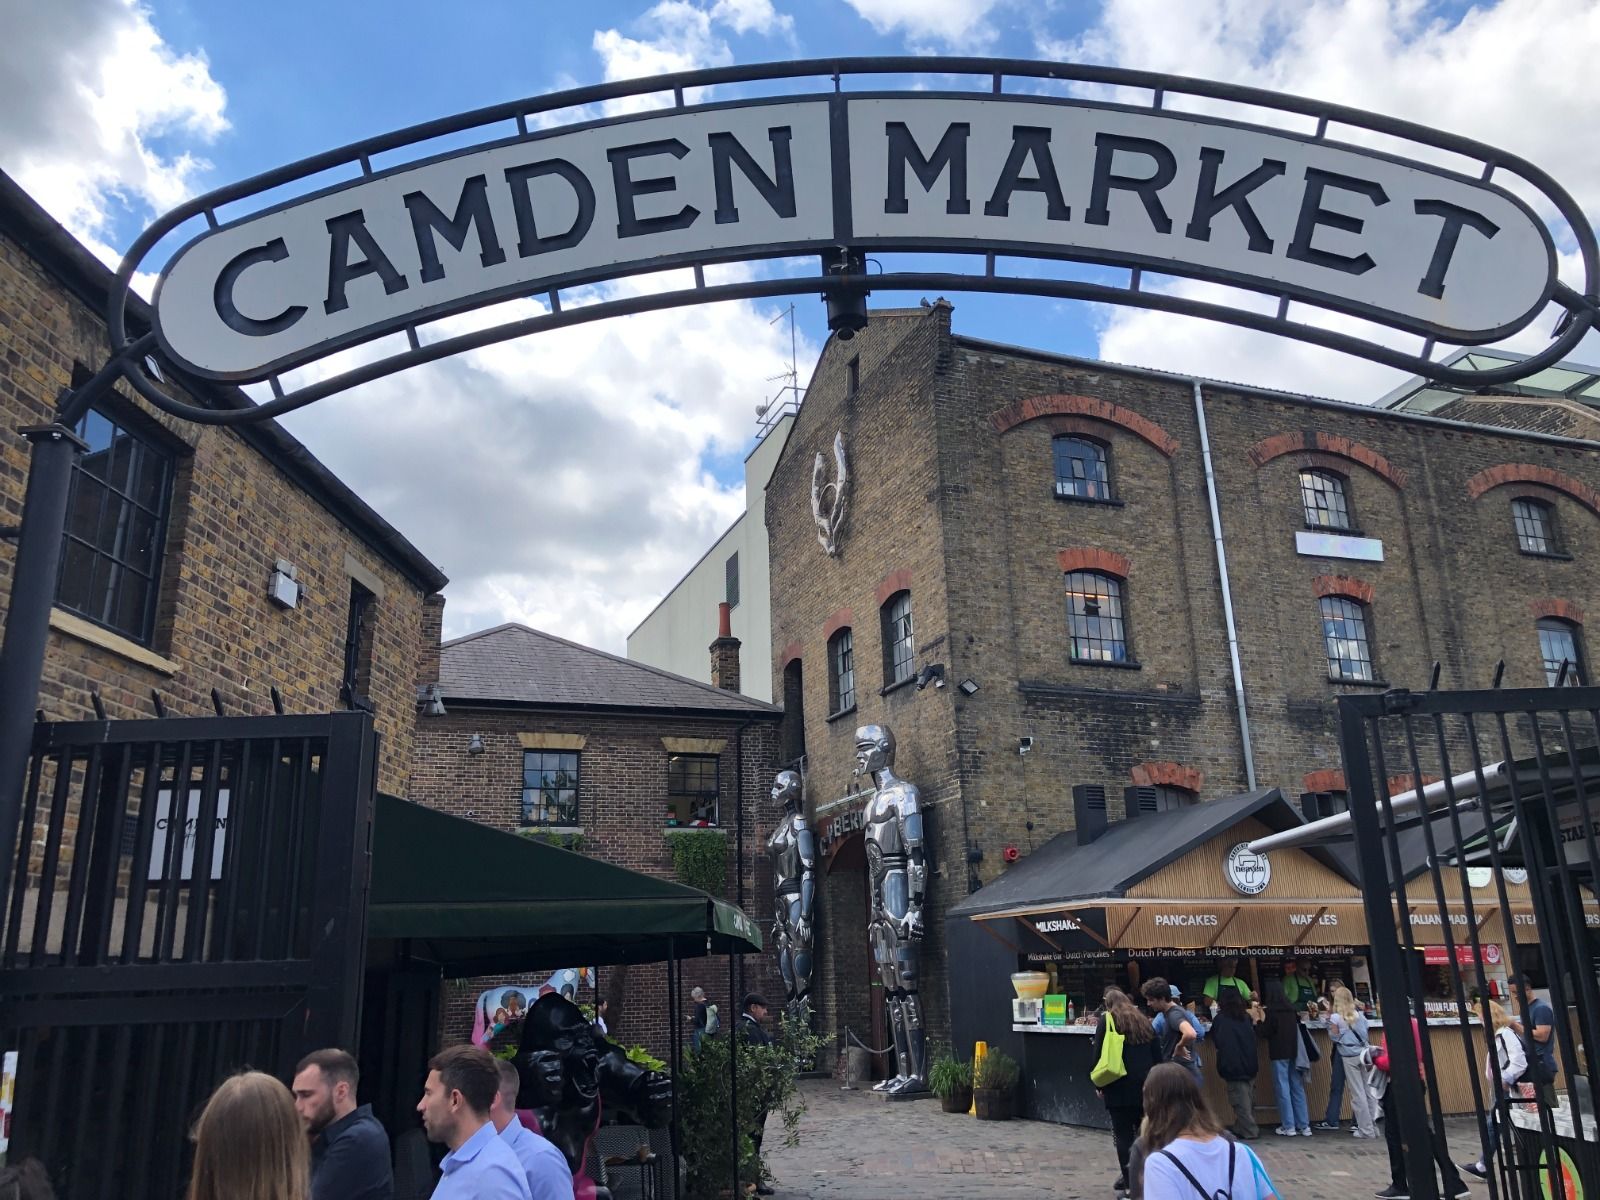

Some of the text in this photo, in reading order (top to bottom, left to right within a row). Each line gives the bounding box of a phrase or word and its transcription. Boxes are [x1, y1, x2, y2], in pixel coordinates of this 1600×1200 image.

[213, 121, 1501, 337] CAMDEN MARKET
[1155, 914, 1218, 926] PANCAKES
[1409, 914, 1442, 925] TALIAN
[1082, 949, 1110, 959] Pancakes
[1128, 945, 1354, 958] Dutch Pancakes Belgian Chocolate Bubble Waffles
